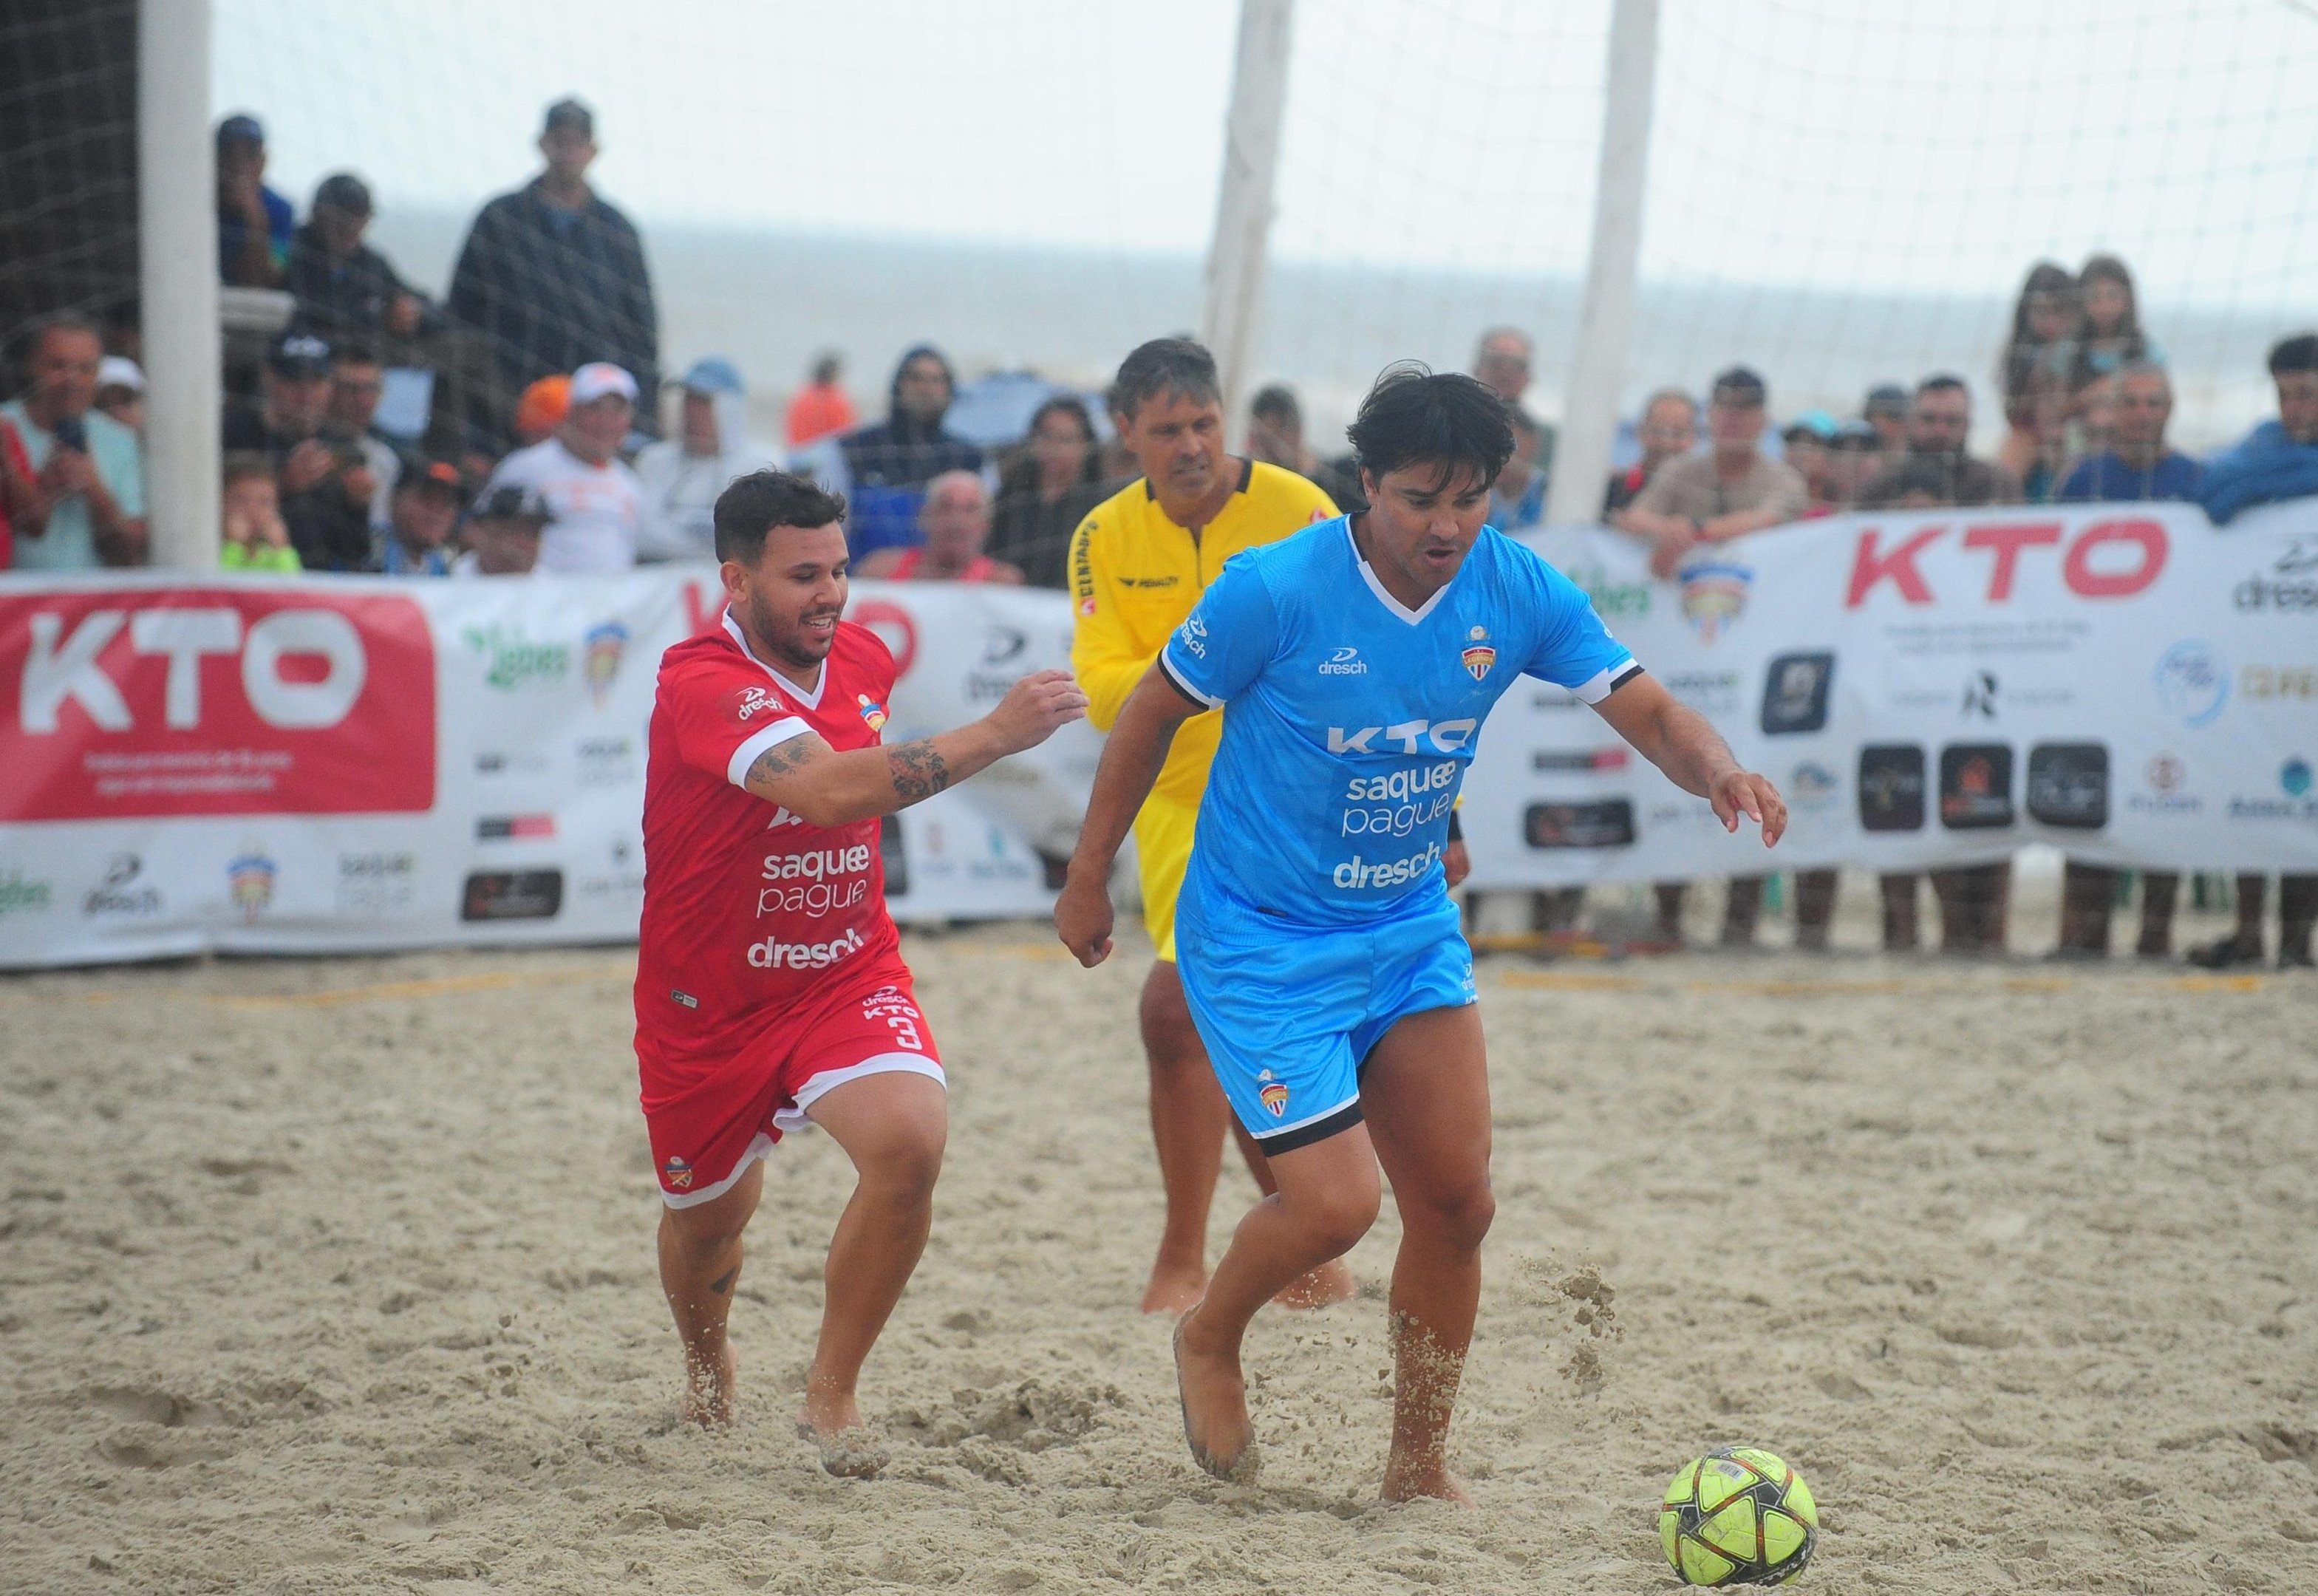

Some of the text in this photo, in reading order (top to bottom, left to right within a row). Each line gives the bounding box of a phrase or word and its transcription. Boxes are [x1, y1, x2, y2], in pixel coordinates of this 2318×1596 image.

[1844, 519, 2170, 609] KTO
[18, 607, 368, 736] KTO
[1318, 661, 1367, 675] dresch
[1327, 718, 1477, 756] KTO
[1346, 760, 1456, 803] saquee
[1341, 793, 1450, 838] pague
[761, 844, 870, 882] saquee
[1333, 841, 1441, 889] dresch
[756, 879, 867, 918] pague
[747, 928, 864, 970] dresch
[863, 1005, 919, 1020] KTO
[887, 1017, 923, 1050] 3
